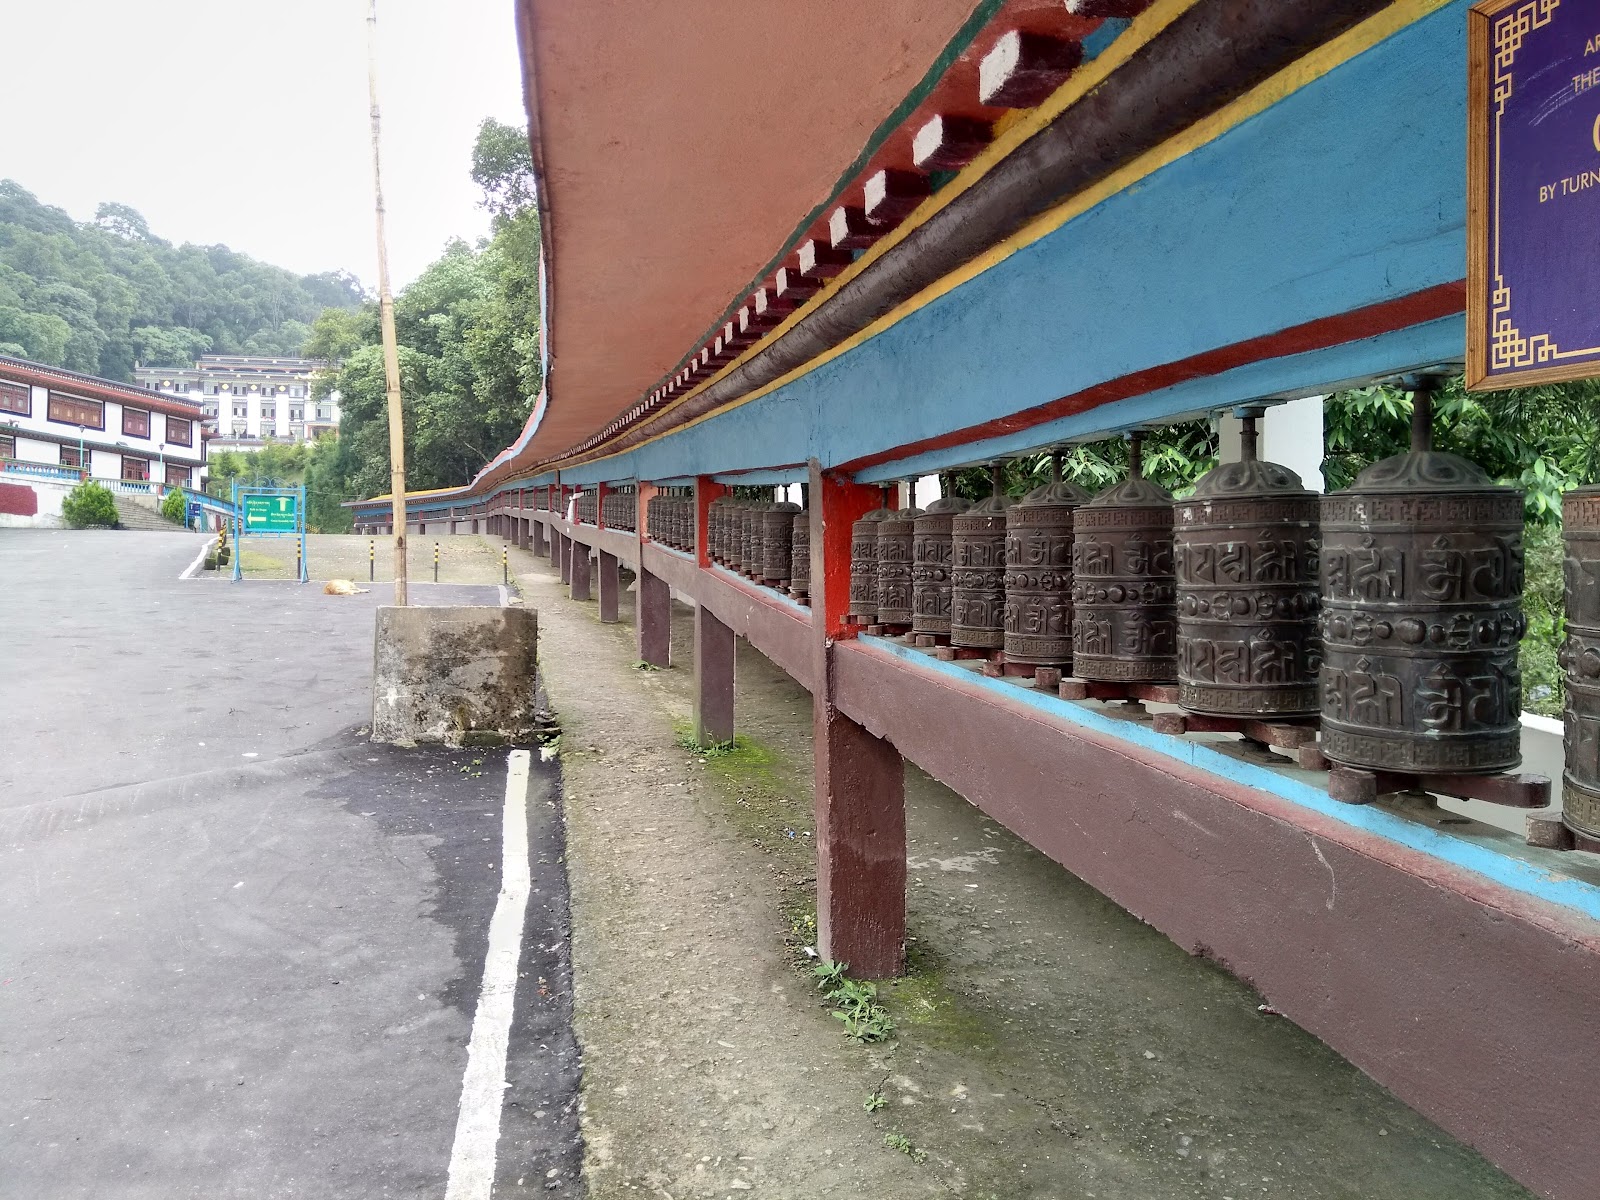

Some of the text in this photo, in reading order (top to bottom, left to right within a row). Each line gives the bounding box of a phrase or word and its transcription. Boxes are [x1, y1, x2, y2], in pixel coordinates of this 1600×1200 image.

[1572, 66, 1600, 92] THE
[1539, 167, 1600, 203] BY TURN
